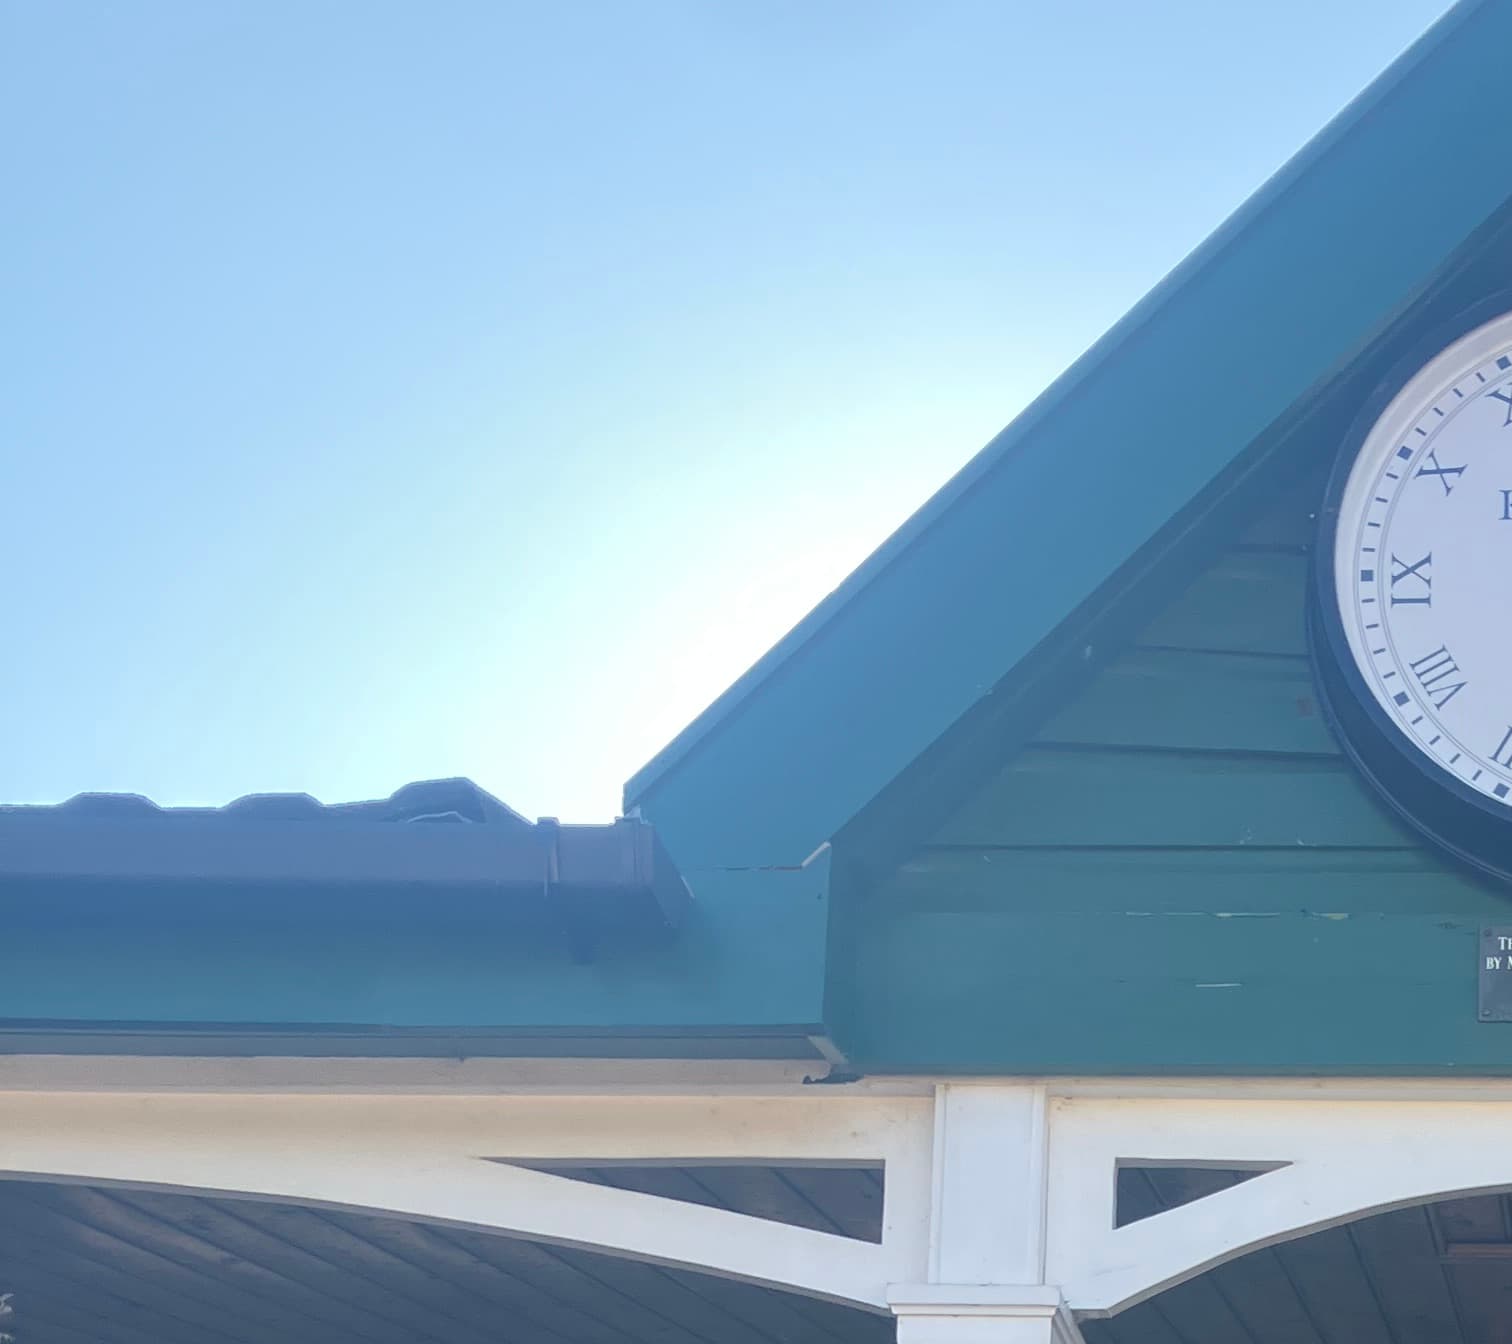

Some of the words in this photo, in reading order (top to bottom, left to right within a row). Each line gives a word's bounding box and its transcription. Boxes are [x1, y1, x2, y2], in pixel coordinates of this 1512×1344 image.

[1414, 449, 1468, 496] X
[1390, 551, 1432, 609] IX
[1408, 645, 1469, 711] VIII
[1486, 956, 1502, 970] BY
